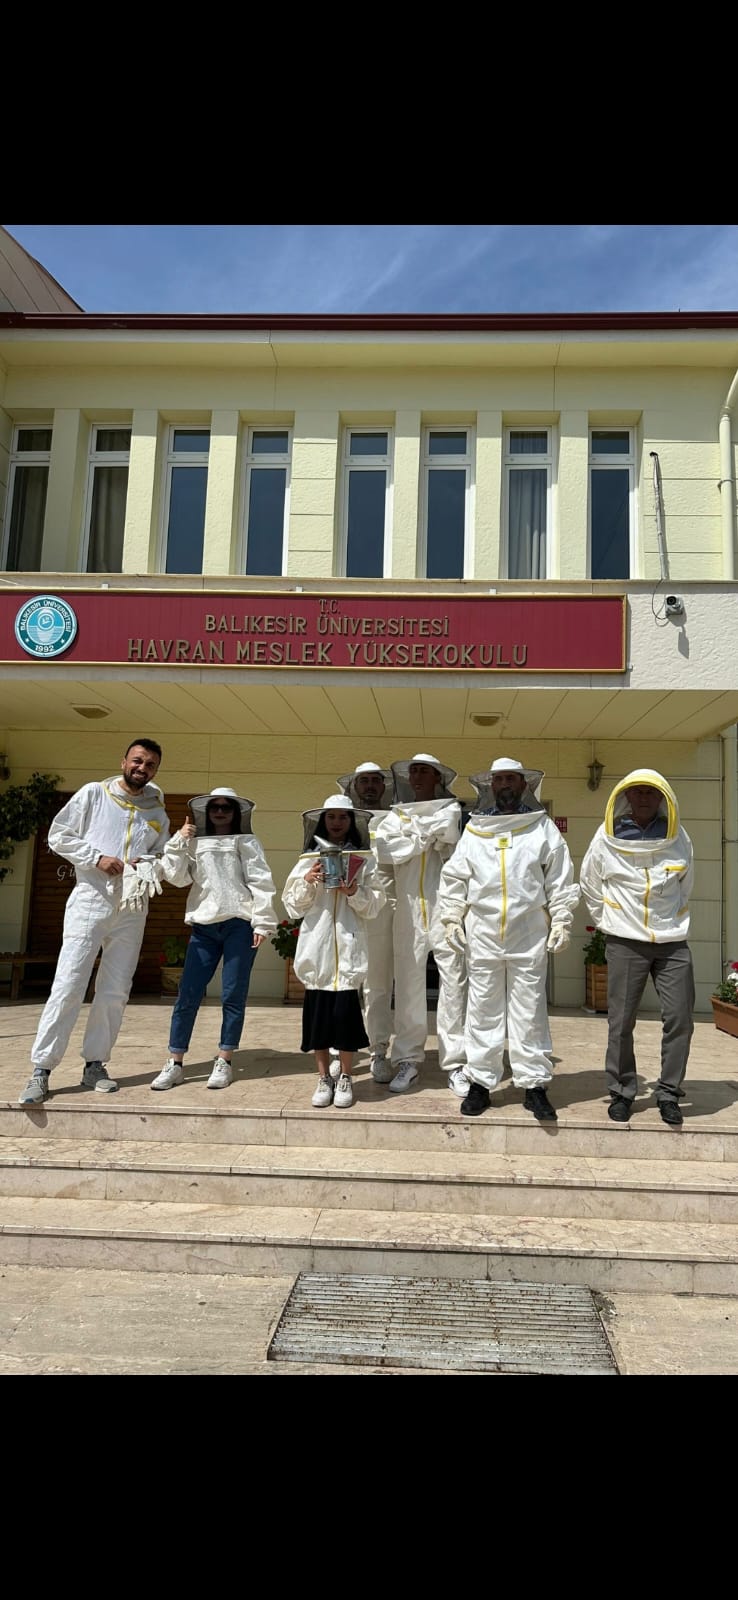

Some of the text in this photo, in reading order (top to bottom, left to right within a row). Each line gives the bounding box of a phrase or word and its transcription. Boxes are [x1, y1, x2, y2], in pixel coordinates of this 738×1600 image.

[319, 599, 341, 614] T.C.
[205, 613, 449, 636] BALIKESİR ÜNİVERSİTESİ
[35, 645, 55, 653] 1992
[127, 638, 528, 666] HAVRAN MESLEK YÜKSEKOKULU
